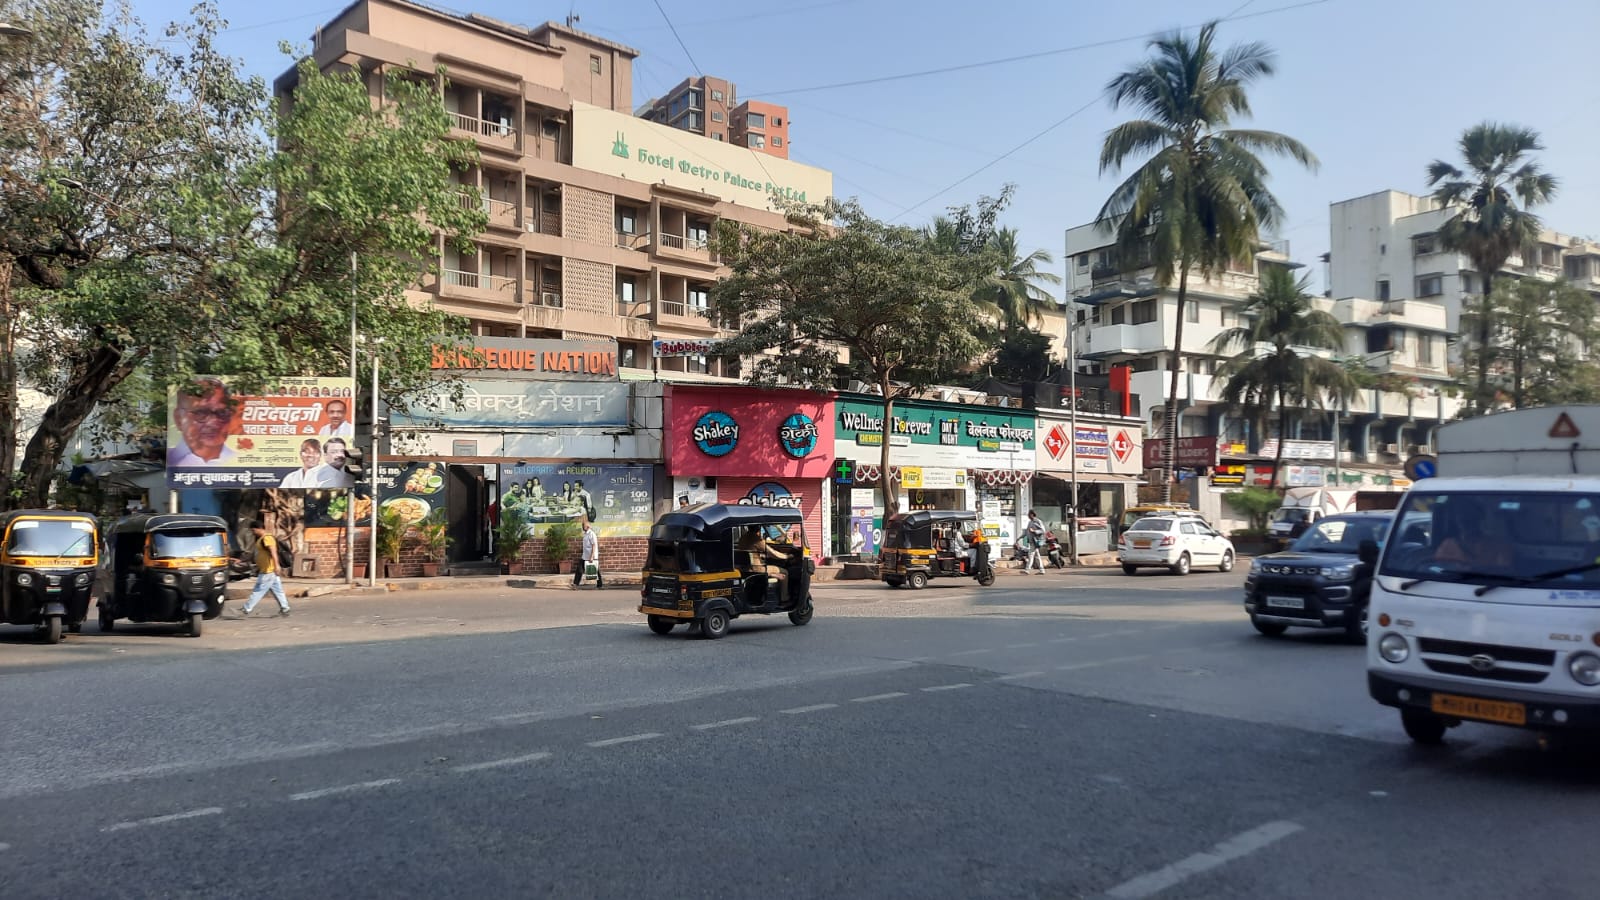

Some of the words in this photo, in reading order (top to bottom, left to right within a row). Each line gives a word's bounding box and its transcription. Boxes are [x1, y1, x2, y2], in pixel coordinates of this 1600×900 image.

[638, 148, 675, 170] Hotel
[678, 159, 720, 181] Metro
[724, 171, 762, 192] Palace
[661, 341, 709, 354] Bubbles
[543, 351, 616, 376] NATION
[538, 388, 605, 413] नेशन
[242, 423, 267, 434] पवार
[269, 422, 297, 434] साहेब
[842, 412, 885, 431] Wellnes
[893, 416, 932, 434] Forever
[941, 421, 952, 432] DAY
[967, 420, 997, 438] वेलनेस
[693, 423, 739, 441] Shakey
[781, 423, 818, 439] शेकी
[941, 433, 958, 445] NIGHT
[611, 472, 644, 484] smiles
[631, 490, 648, 498] 100
[631, 505, 648, 513] 100
